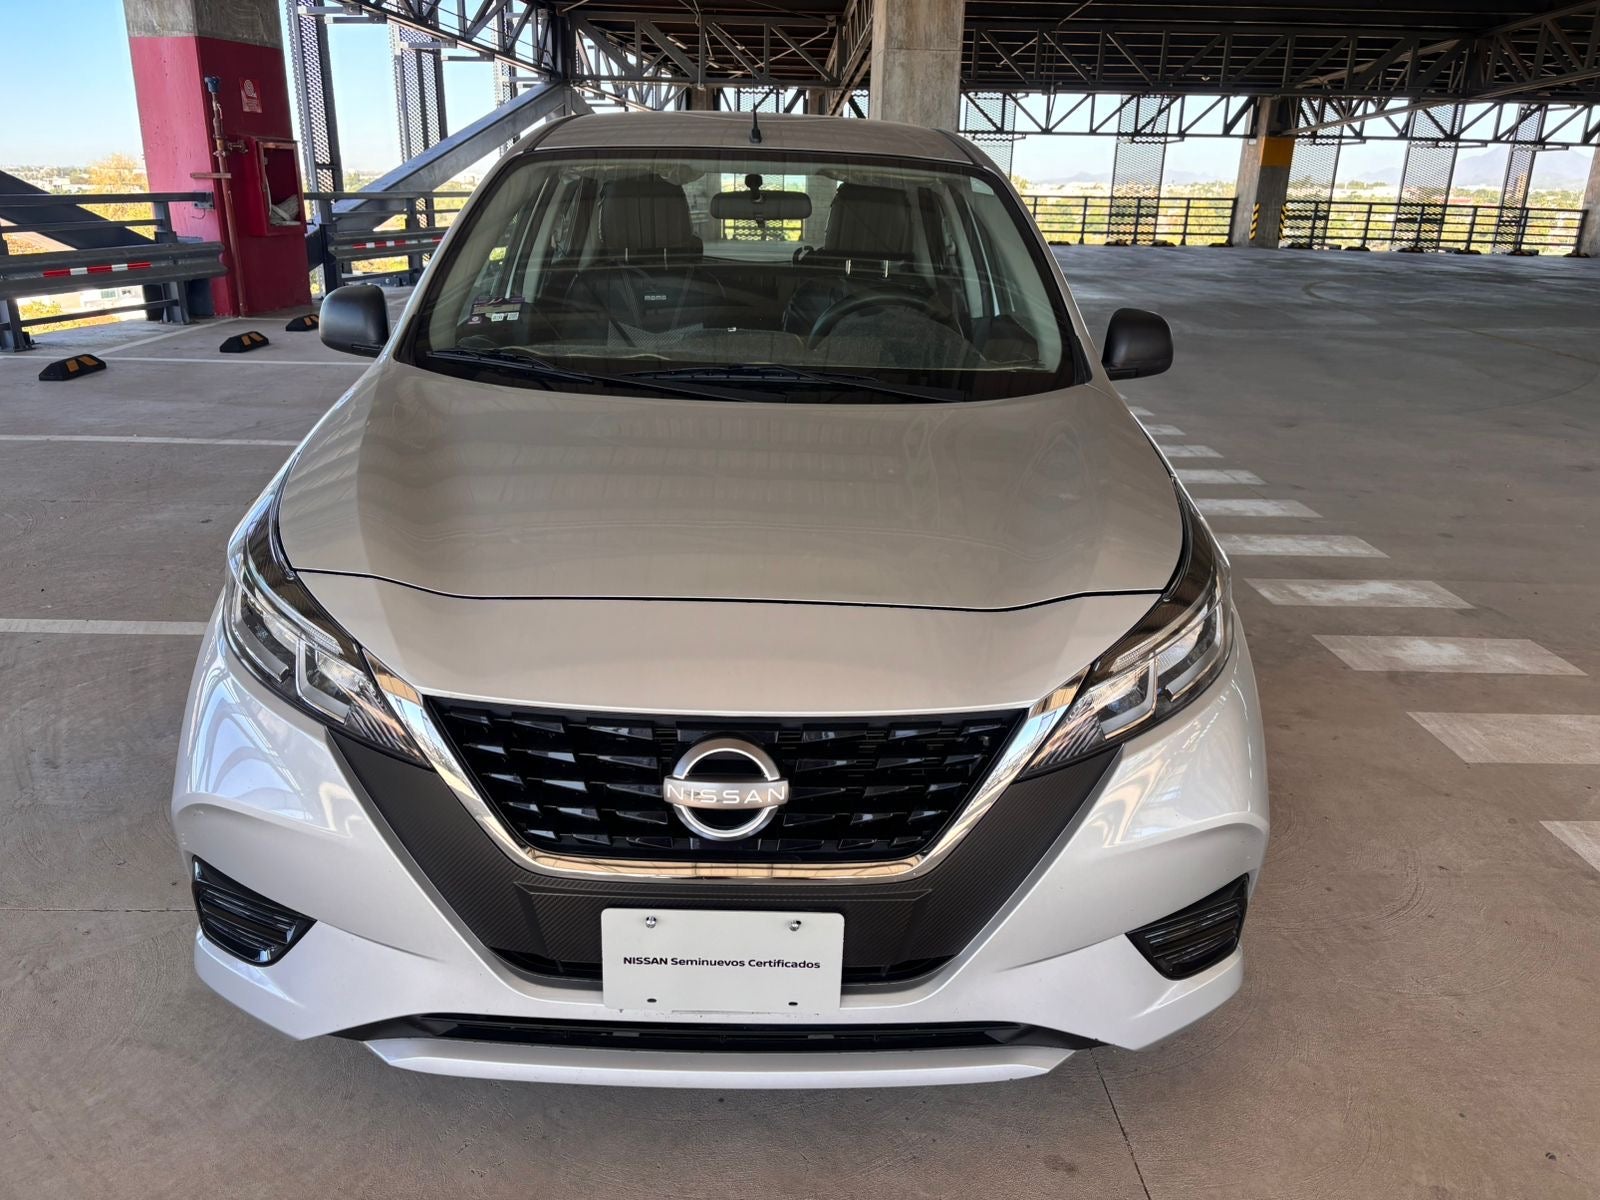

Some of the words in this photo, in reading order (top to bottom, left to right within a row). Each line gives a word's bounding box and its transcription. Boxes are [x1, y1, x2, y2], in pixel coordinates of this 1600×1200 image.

[667, 784, 785, 804] NISSAN
[623, 956, 668, 966] NISSAN
[670, 957, 746, 967] Seminuevos
[748, 959, 821, 969] Certificados
